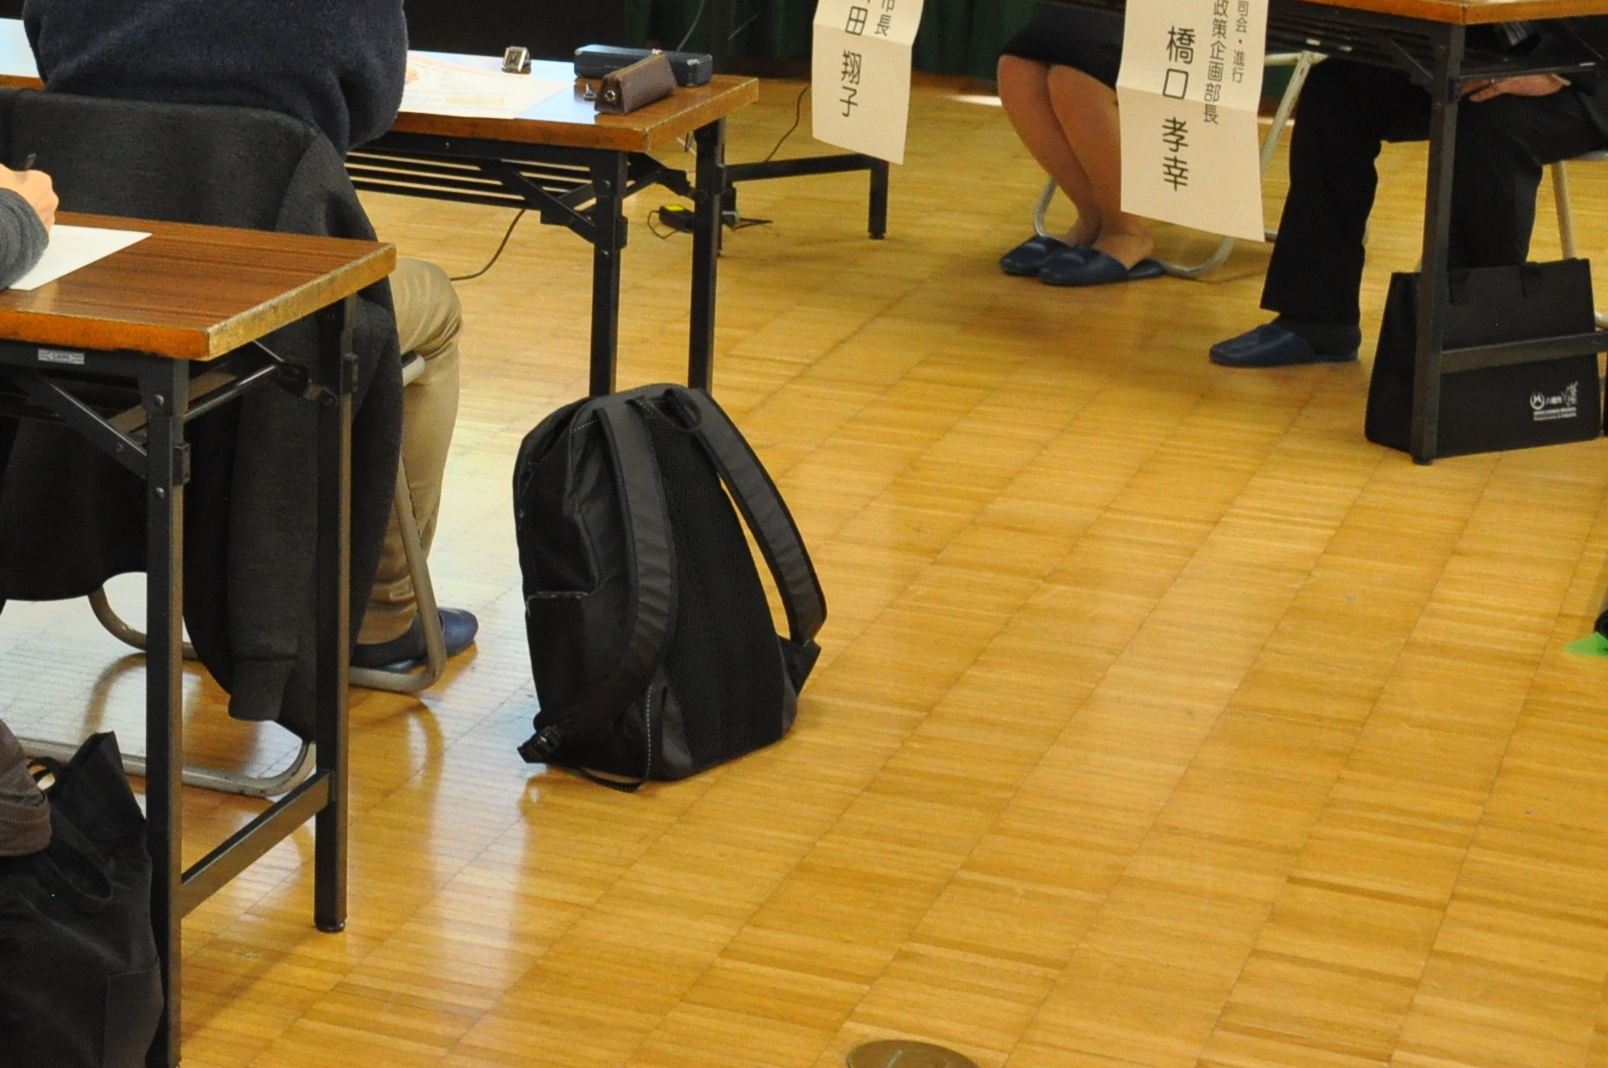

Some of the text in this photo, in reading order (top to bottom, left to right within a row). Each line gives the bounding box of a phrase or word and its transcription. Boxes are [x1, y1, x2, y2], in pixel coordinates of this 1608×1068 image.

[839, 49, 863, 118] 翔子
[1231, 0, 1250, 84] 司会・進行
[1161, 25, 1196, 192] 橋口 孝幸
